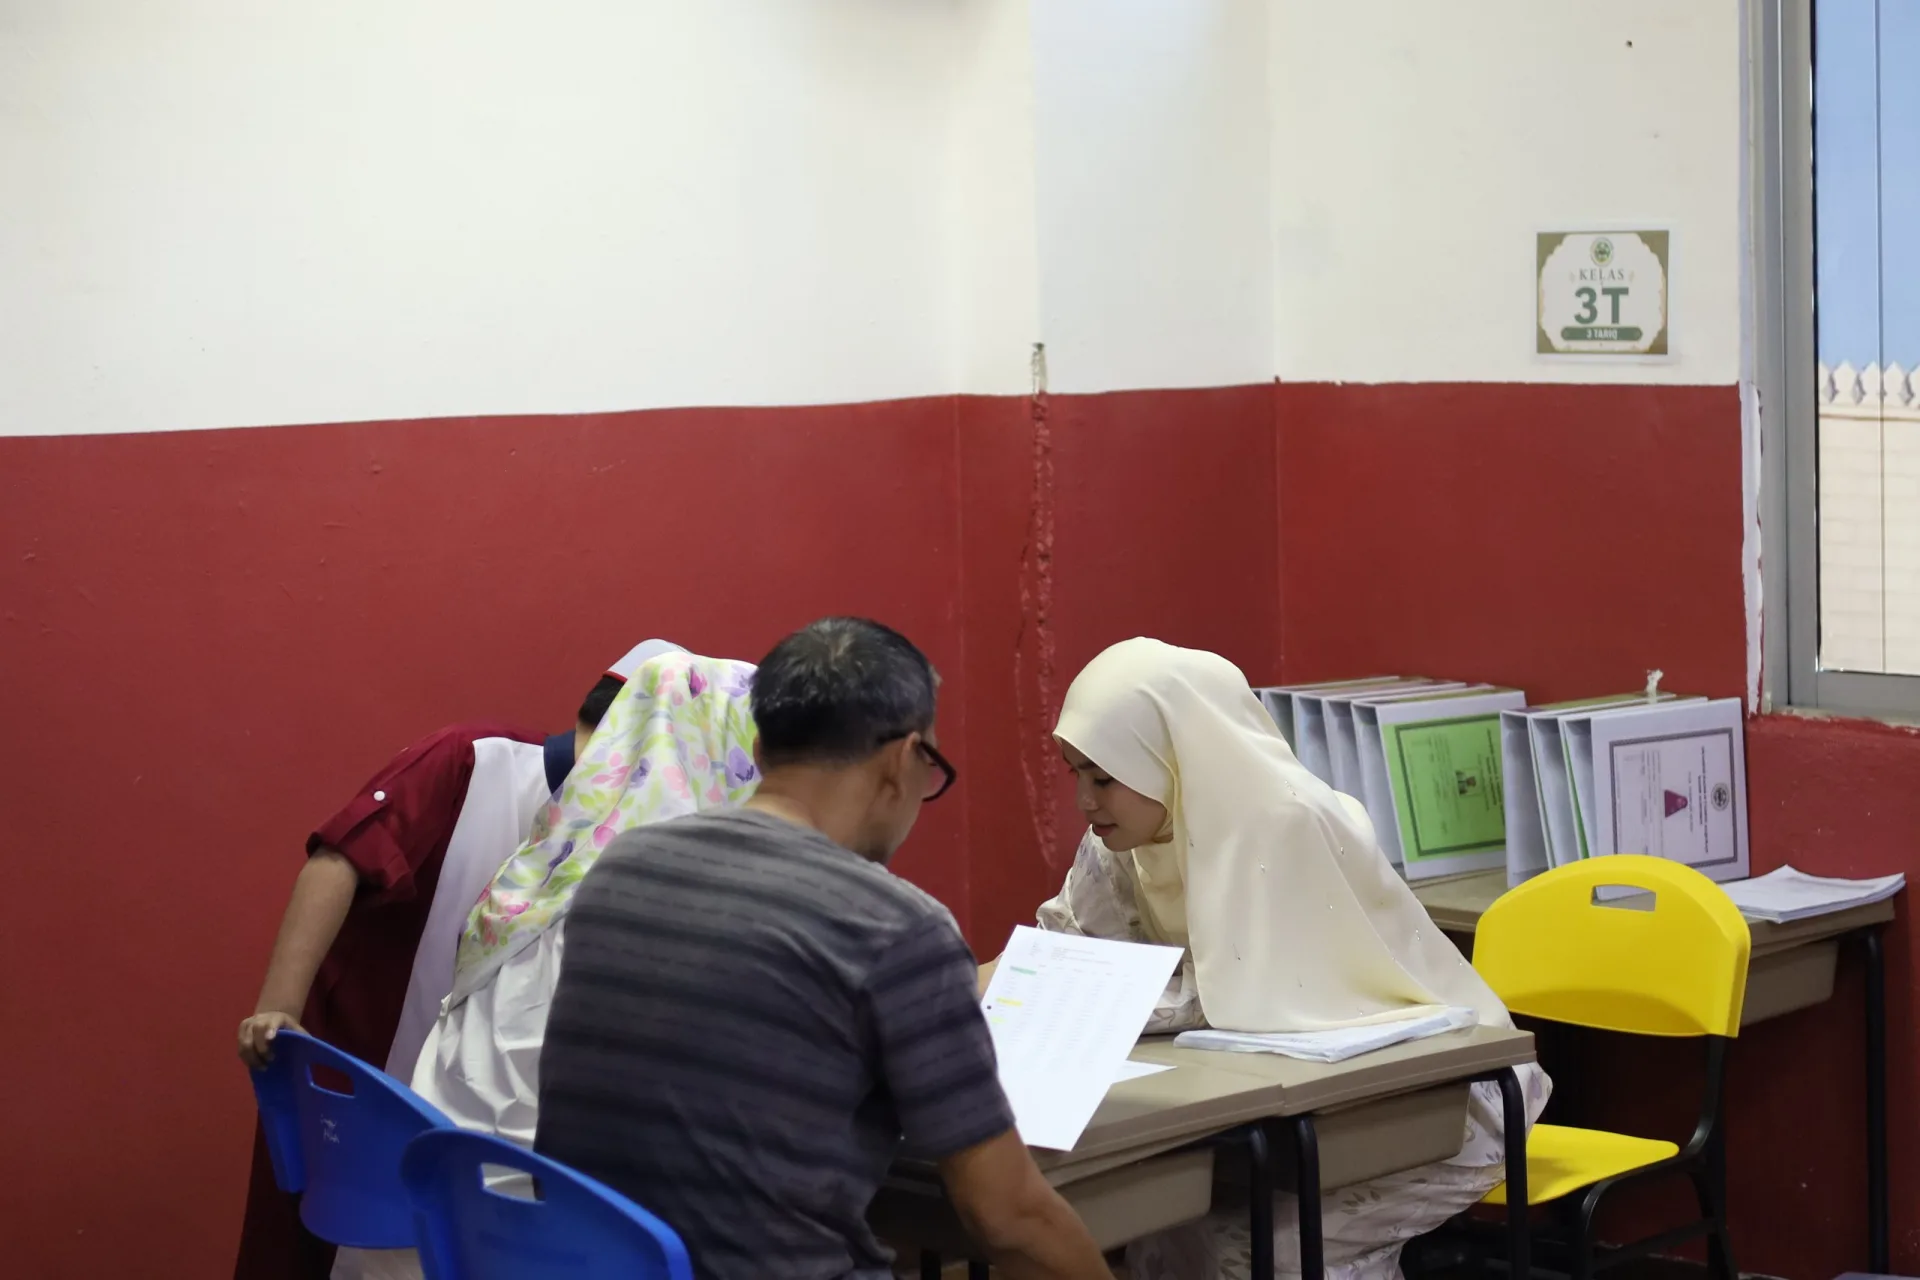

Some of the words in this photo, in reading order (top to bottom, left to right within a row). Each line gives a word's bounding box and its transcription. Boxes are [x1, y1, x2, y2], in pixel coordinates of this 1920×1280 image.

[1579, 268, 1625, 281] KELAS
[1574, 286, 1629, 325] 3T
[1586, 329, 1592, 339] 3
